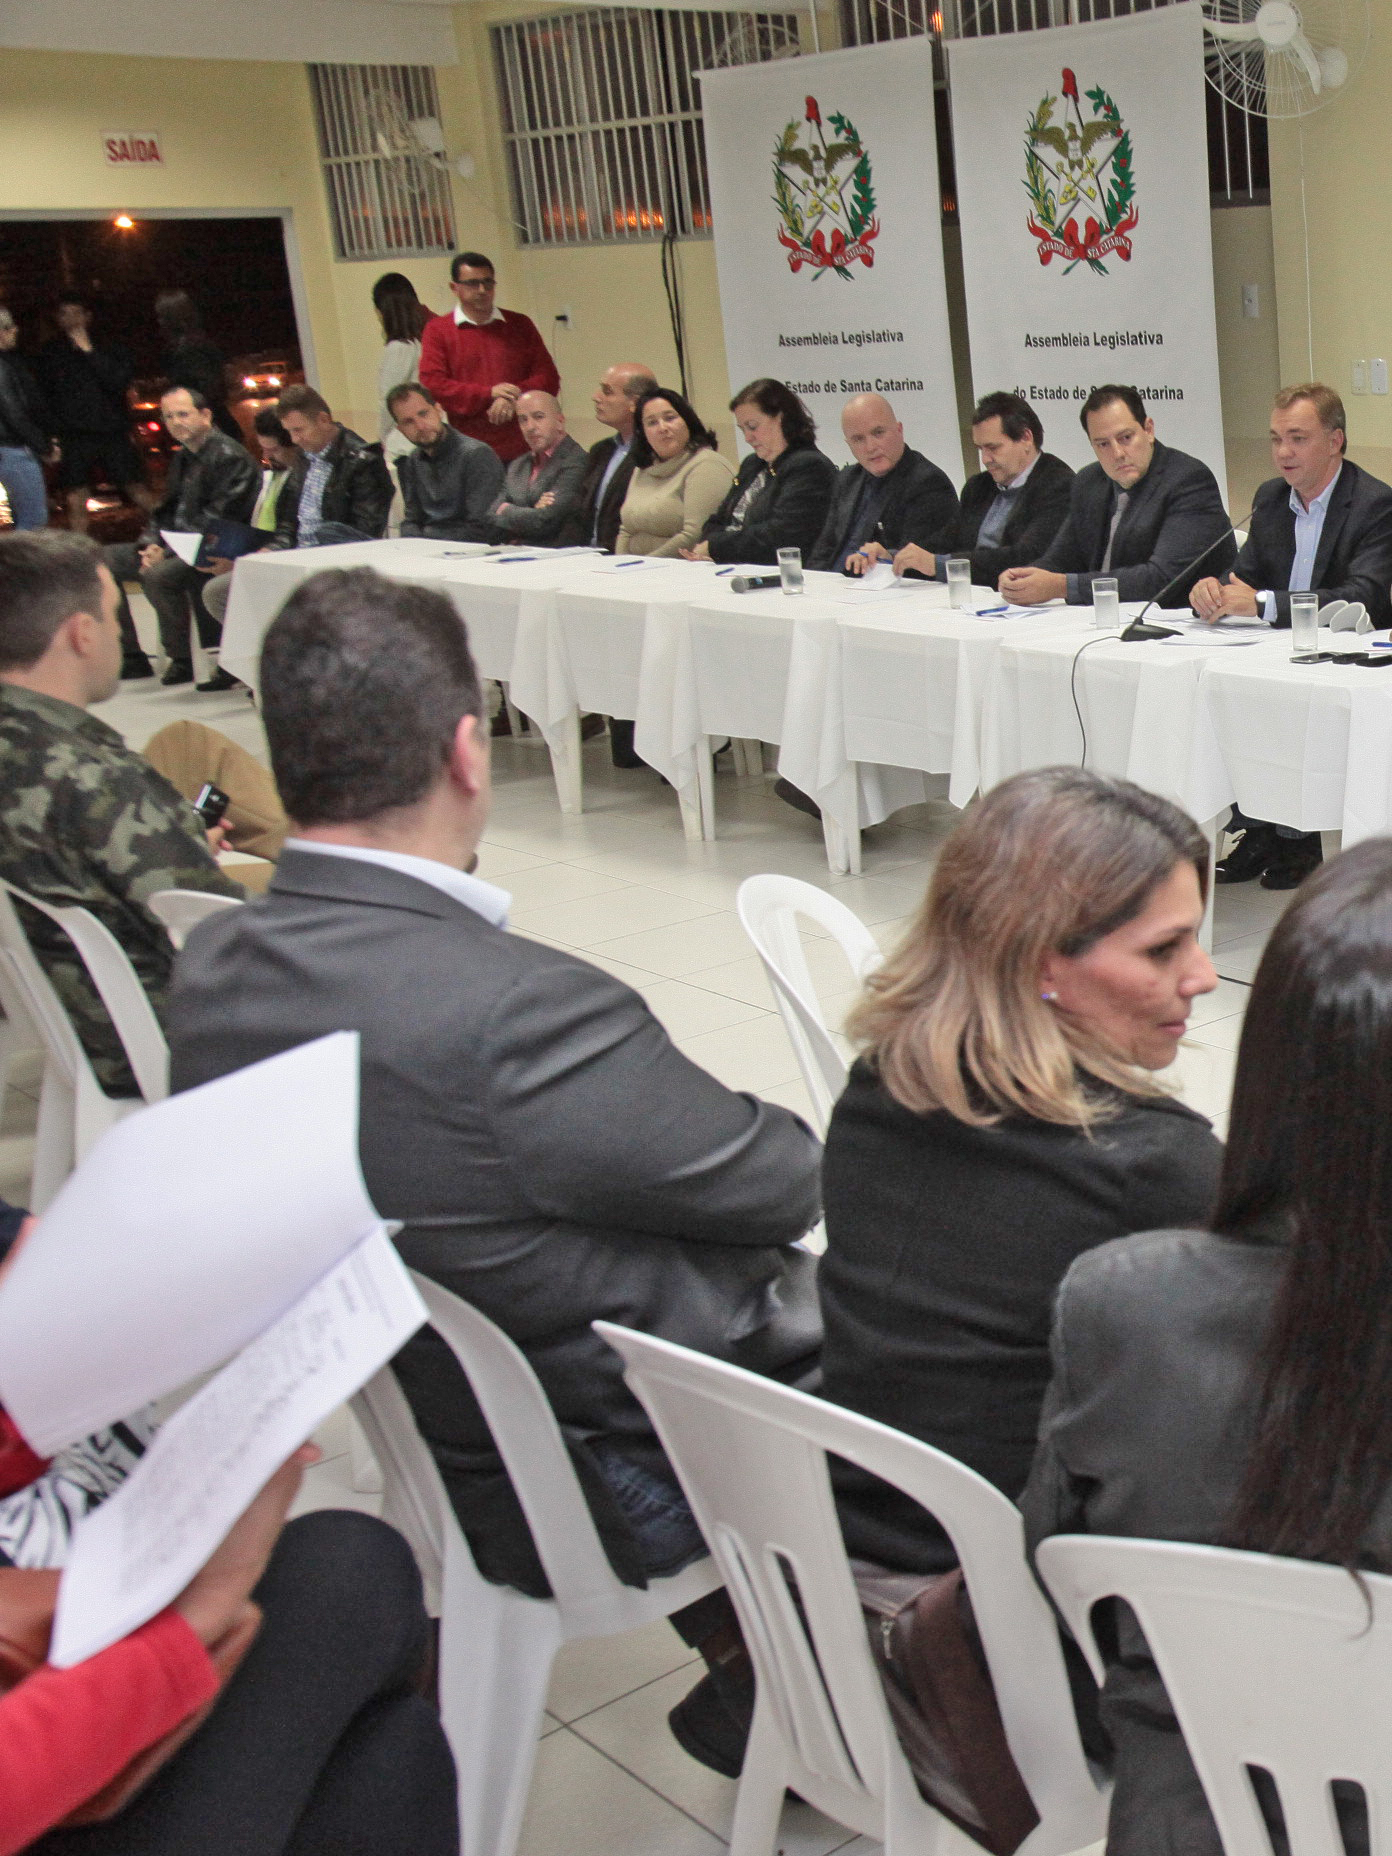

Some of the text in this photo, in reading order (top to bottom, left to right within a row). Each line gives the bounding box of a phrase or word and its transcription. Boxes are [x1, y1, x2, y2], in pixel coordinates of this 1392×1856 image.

[106, 133, 161, 161] SAÍDA
[1039, 240, 1064, 255] ESTADO
[1064, 247, 1075, 258] DE
[1100, 236, 1131, 253] CATARINA
[779, 329, 904, 347] Assembleia Legislativa
[1025, 330, 1164, 350] Assembleia Legislativa
[785, 378, 924, 394] Estado de Santa Catarina
[1013, 386, 1026, 399] do
[1030, 385, 1069, 400] Estado
[1072, 385, 1087, 399] de
[1132, 385, 1184, 400] atarina
